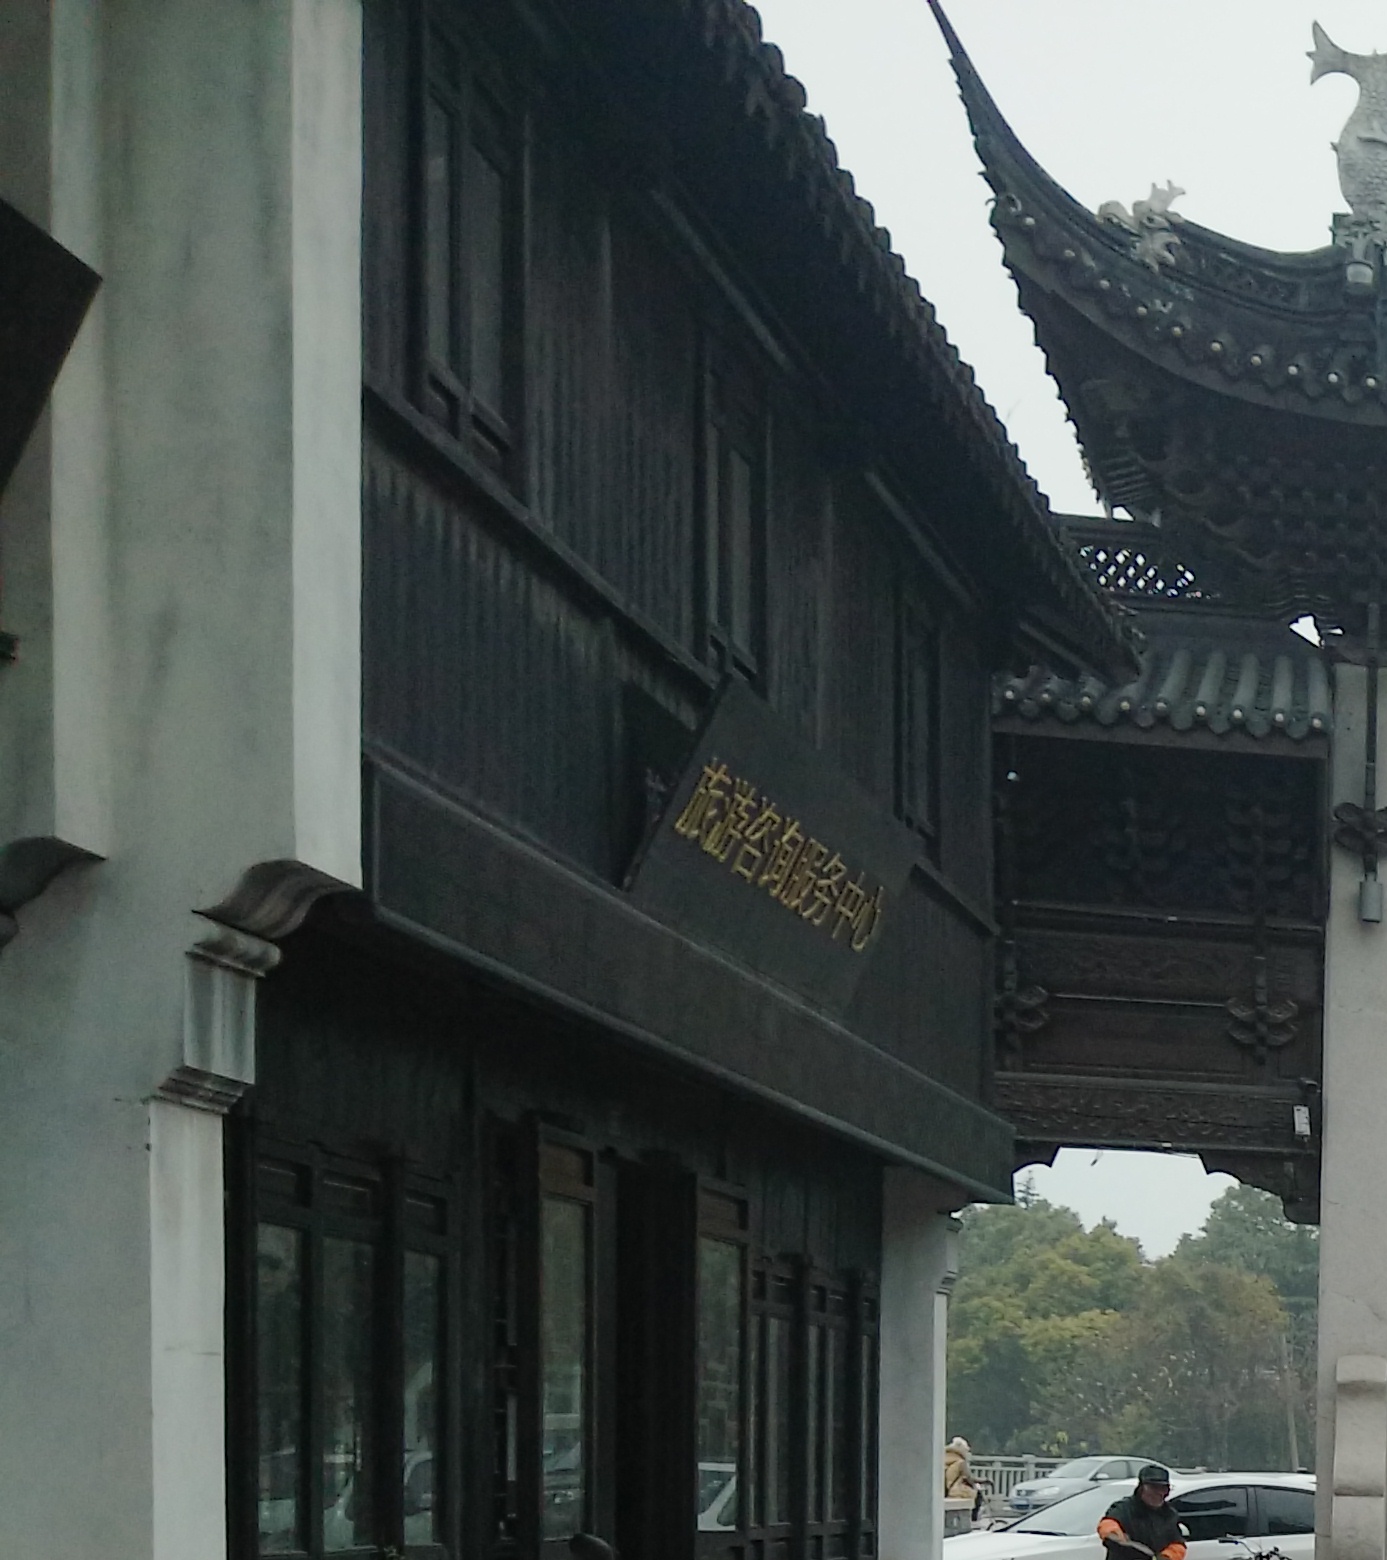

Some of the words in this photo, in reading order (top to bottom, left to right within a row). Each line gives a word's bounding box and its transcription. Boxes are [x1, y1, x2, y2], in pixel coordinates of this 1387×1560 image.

[675, 757, 884, 951] 旅游咨询服务中心
